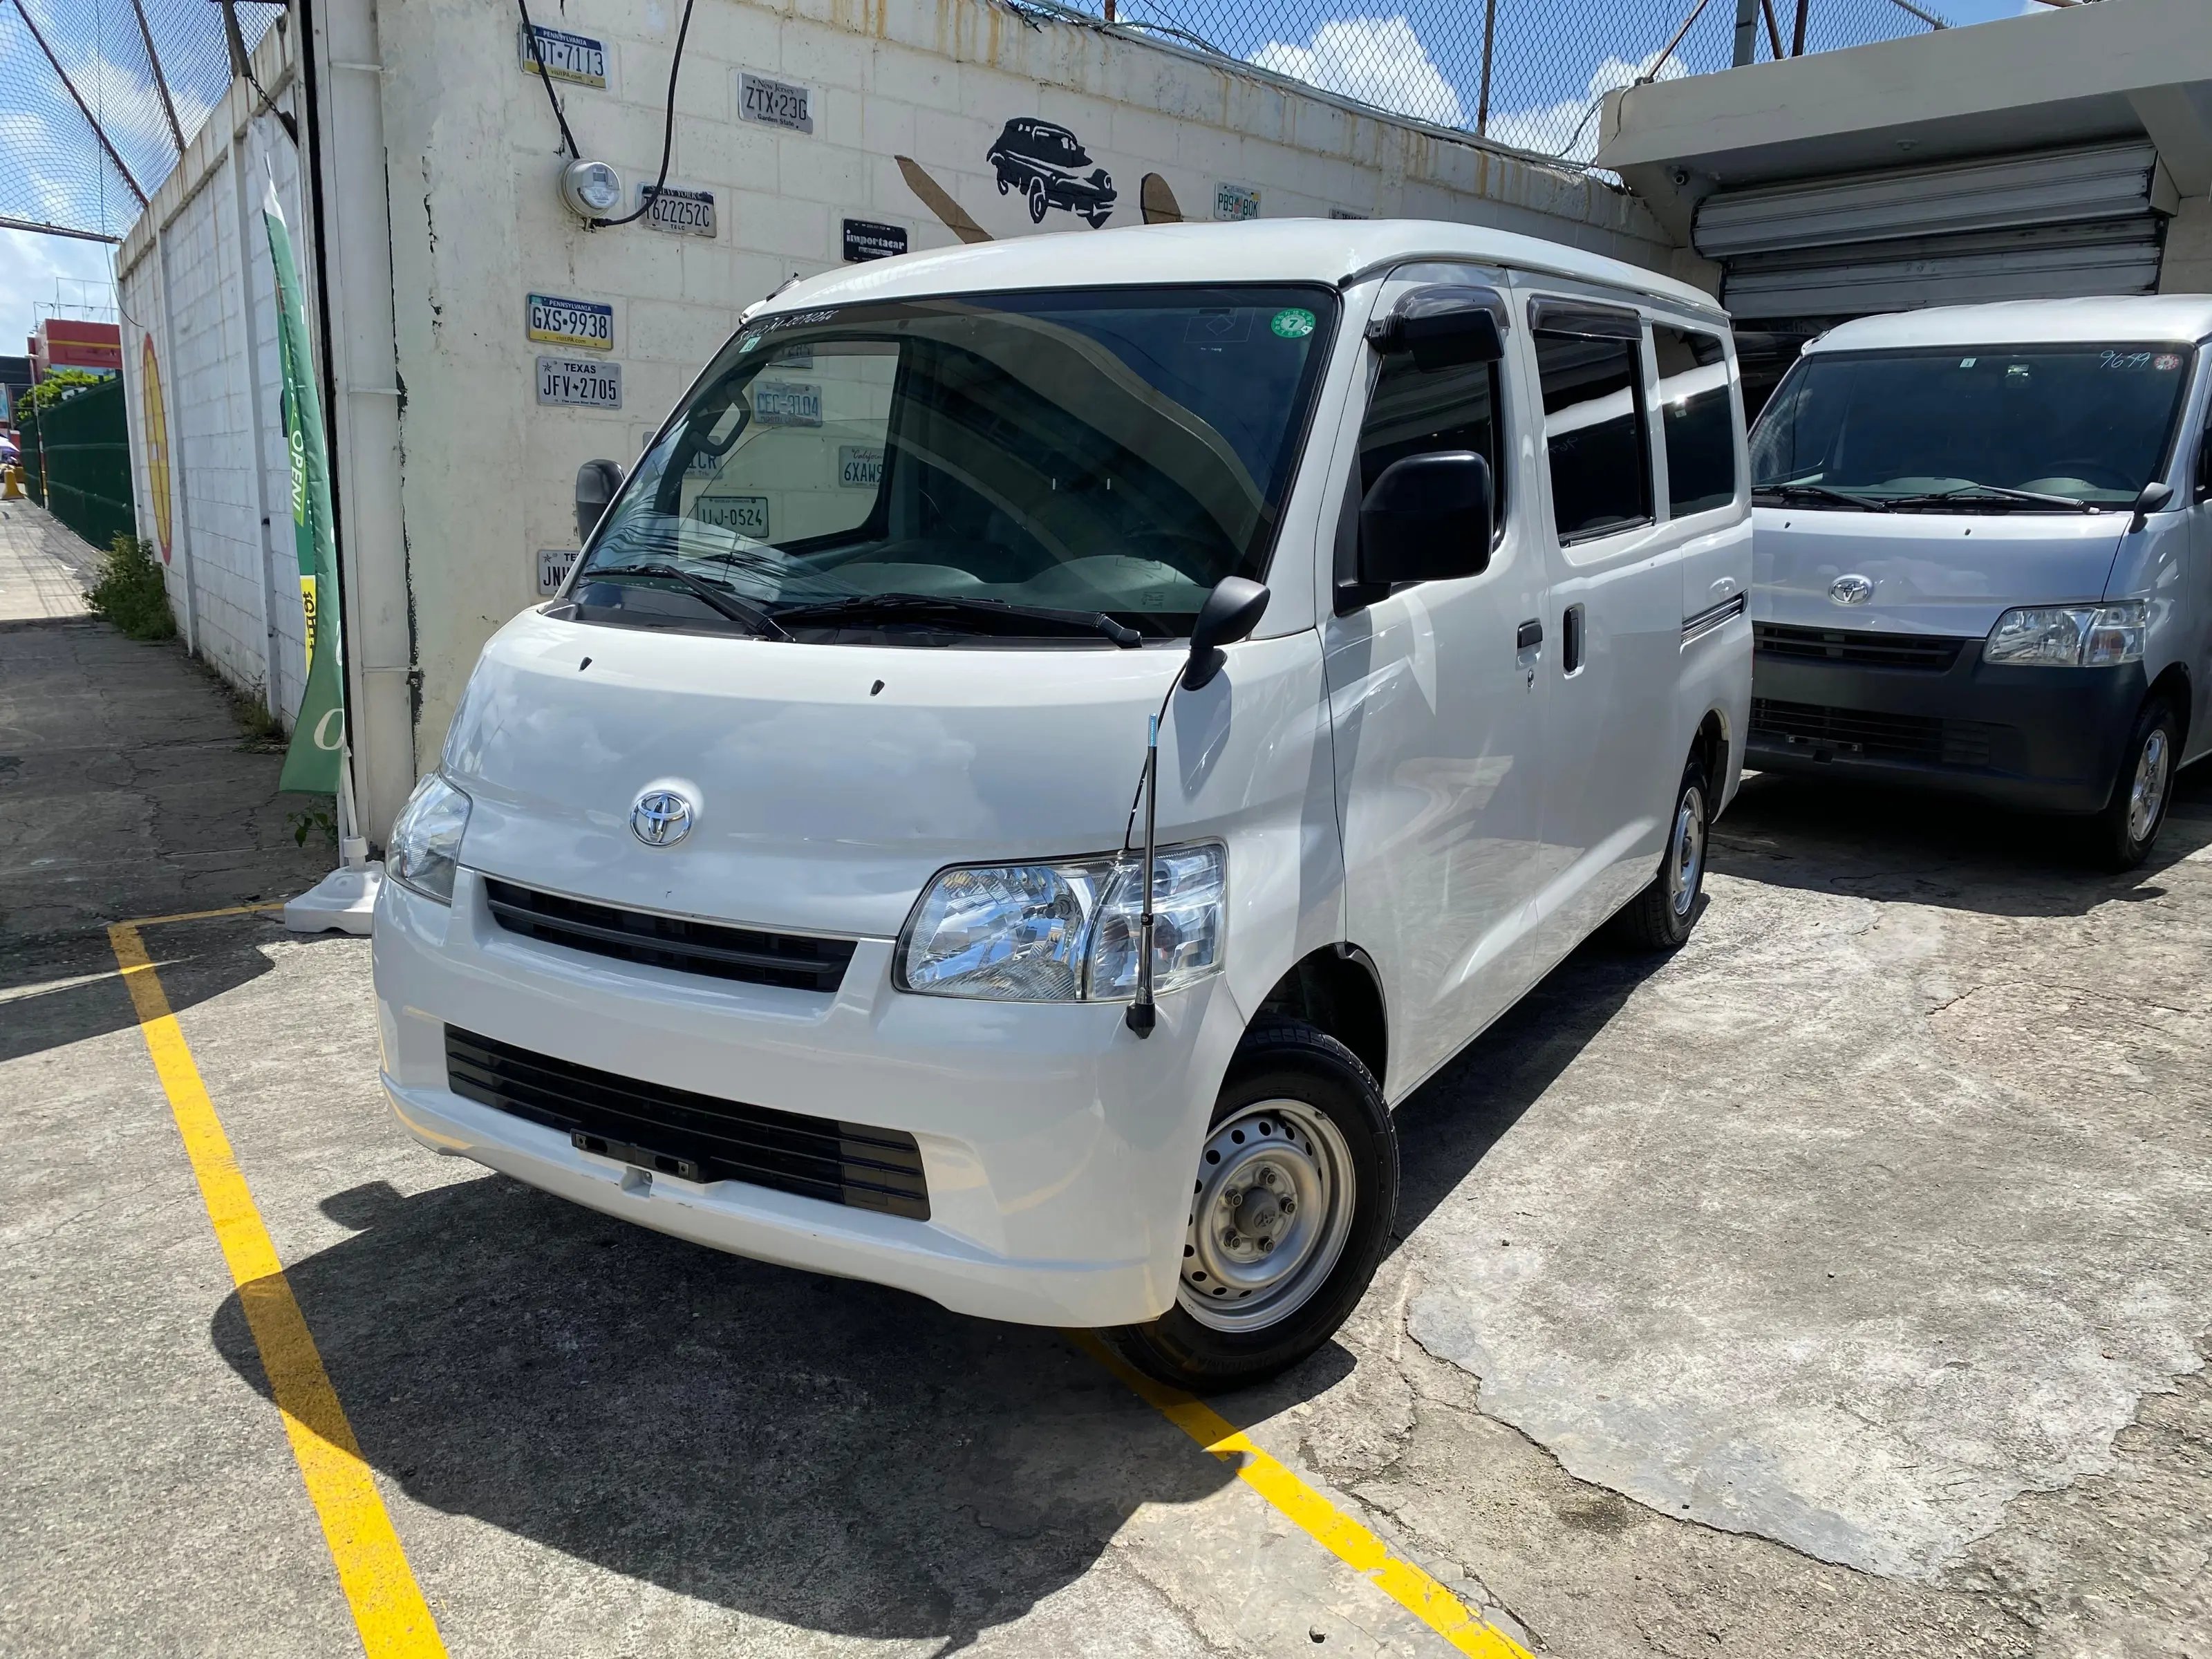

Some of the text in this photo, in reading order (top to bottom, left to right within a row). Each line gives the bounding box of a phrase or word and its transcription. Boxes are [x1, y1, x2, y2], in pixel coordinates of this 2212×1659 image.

[543, 30, 587, 46] PENNSYLVANIA
[563, 44, 603, 77] 7113
[551, 70, 582, 80] visitPA.com
[758, 79, 794, 95] New Jersey
[746, 86, 774, 114] ZTX
[757, 113, 794, 127] Garden State
[677, 191, 697, 200] YORK
[846, 229, 905, 250] importacar
[549, 300, 592, 312] PENNSYLVANIA
[532, 306, 608, 339] GXS 9938
[1289, 319, 1298, 328] 7
[556, 335, 586, 344] visitPA.com
[564, 363, 596, 374] TEXAS
[543, 375, 617, 401] JFV 2705
